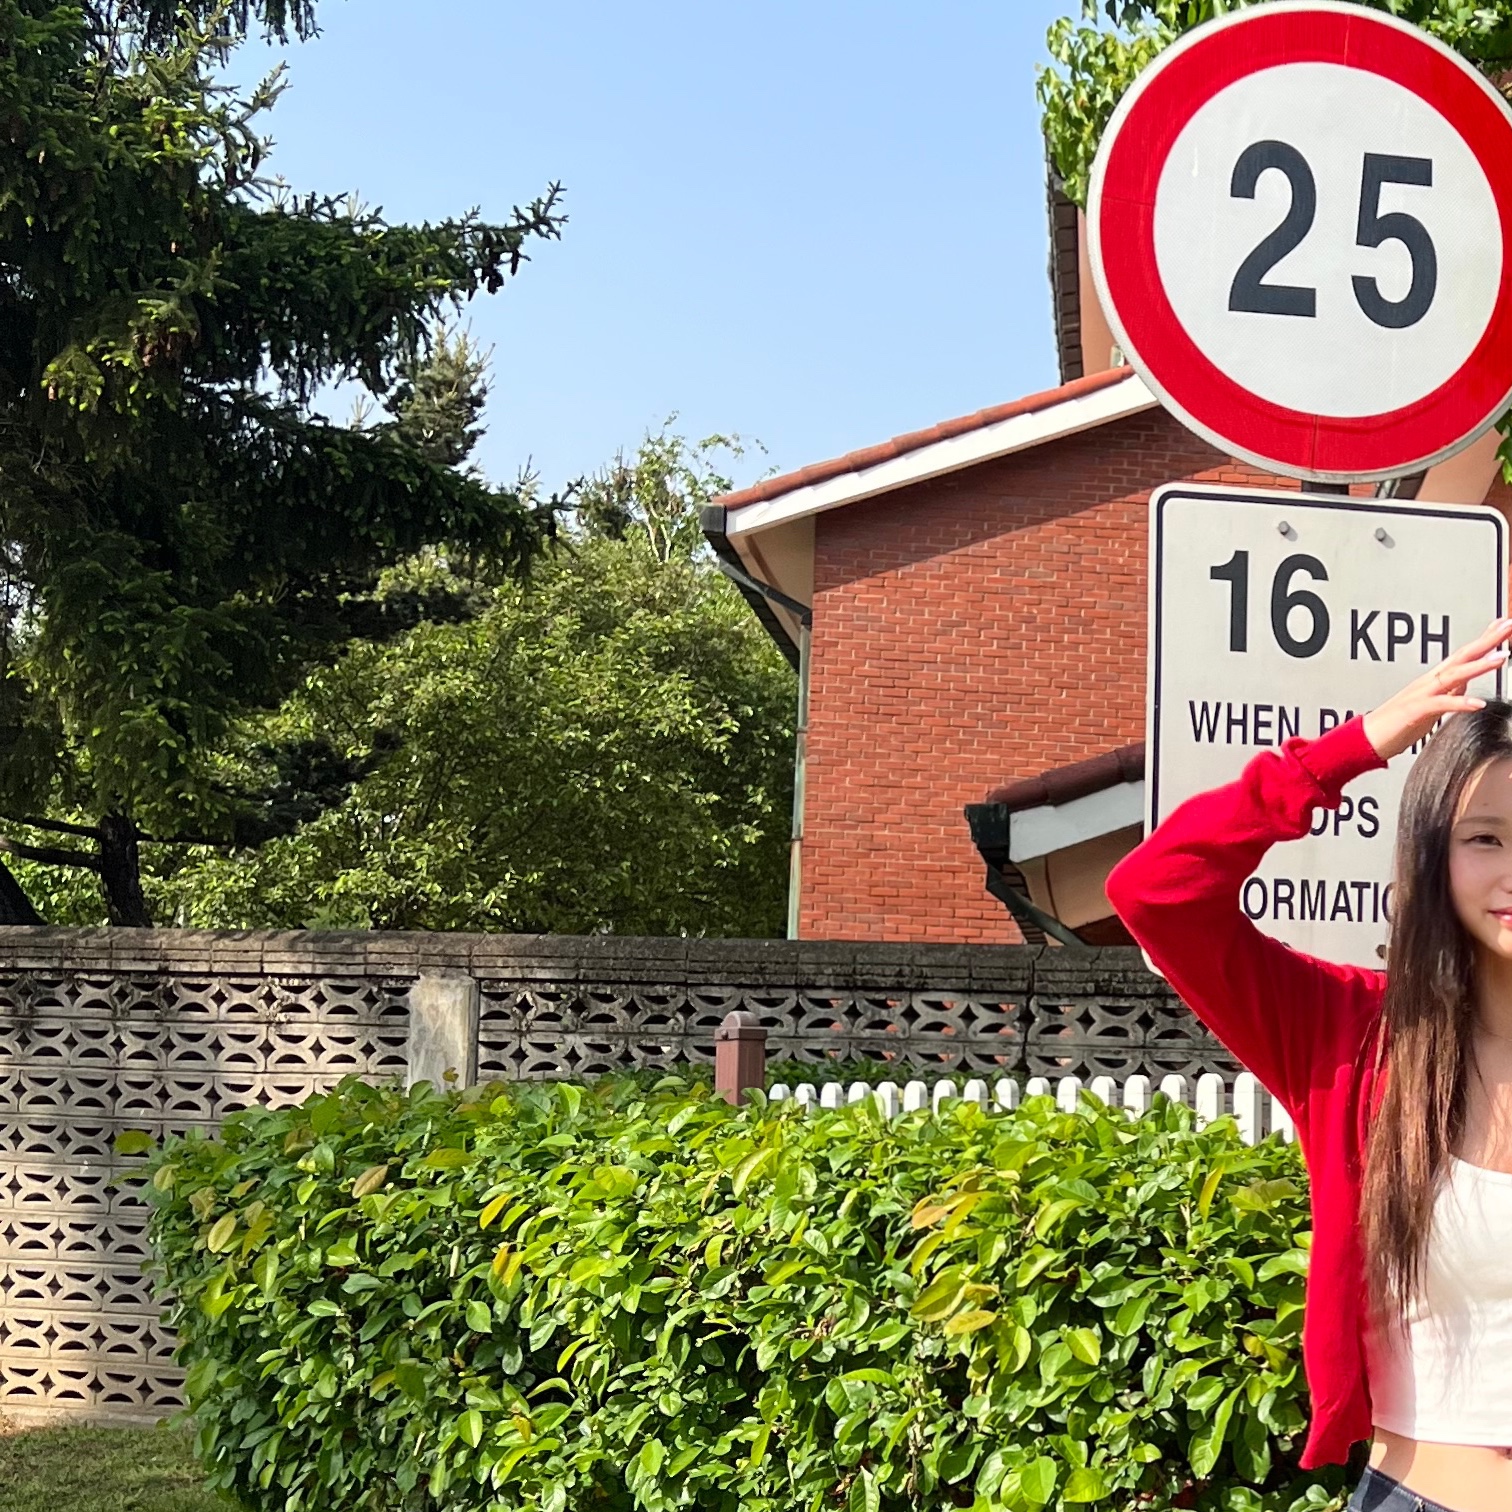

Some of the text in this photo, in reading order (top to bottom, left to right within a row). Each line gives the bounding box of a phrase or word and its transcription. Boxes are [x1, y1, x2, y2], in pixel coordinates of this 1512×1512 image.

[1228, 139, 1438, 330] 25
[1210, 549, 1451, 665] 16 KPH
[1188, 699, 1300, 747] WHEN
